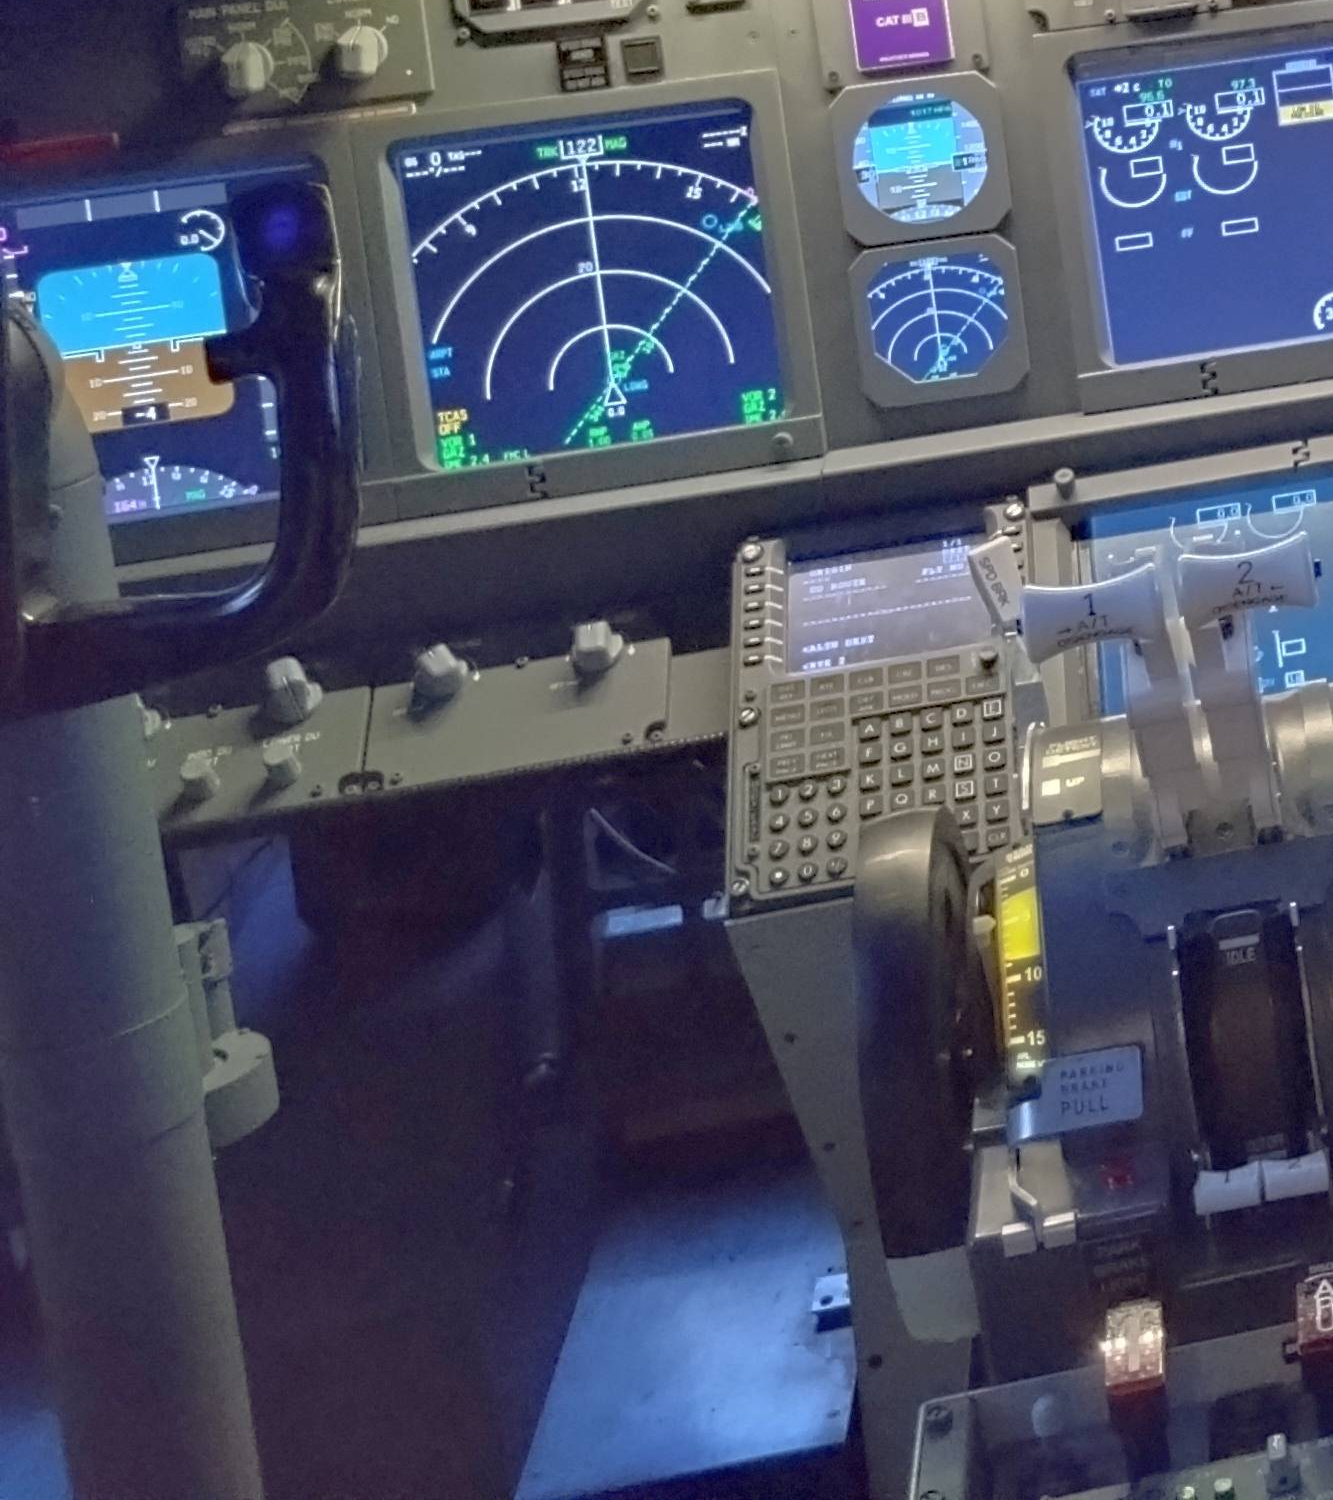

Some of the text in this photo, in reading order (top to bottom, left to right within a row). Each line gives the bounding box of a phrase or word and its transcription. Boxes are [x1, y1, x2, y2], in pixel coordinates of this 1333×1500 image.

[875, 15, 900, 28] CAT
[1231, 78, 1256, 90] 97.3
[1236, 92, 1262, 104] 0.1
[1144, 105, 1170, 117] 0.1
[567, 142, 597, 154] 122
[605, 138, 627, 149] MAG
[430, 152, 441, 166] 0
[180, 234, 199, 246] 0.0
[437, 410, 467, 421] TCAS
[438, 421, 461, 434] OFF
[1238, 561, 1255, 585] 2
[979, 556, 1009, 607] SPD BRK
[1232, 583, 1262, 597] A/T
[1084, 593, 1096, 616] 1
[1078, 615, 1109, 630] A/T
[1066, 777, 1085, 787] UP
[1020, 867, 1029, 879] 0
[1226, 947, 1256, 965] IDLE
[1025, 966, 1042, 981] 10
[1027, 1030, 1046, 1046] 15
[1061, 1100, 1109, 1115] PULL
